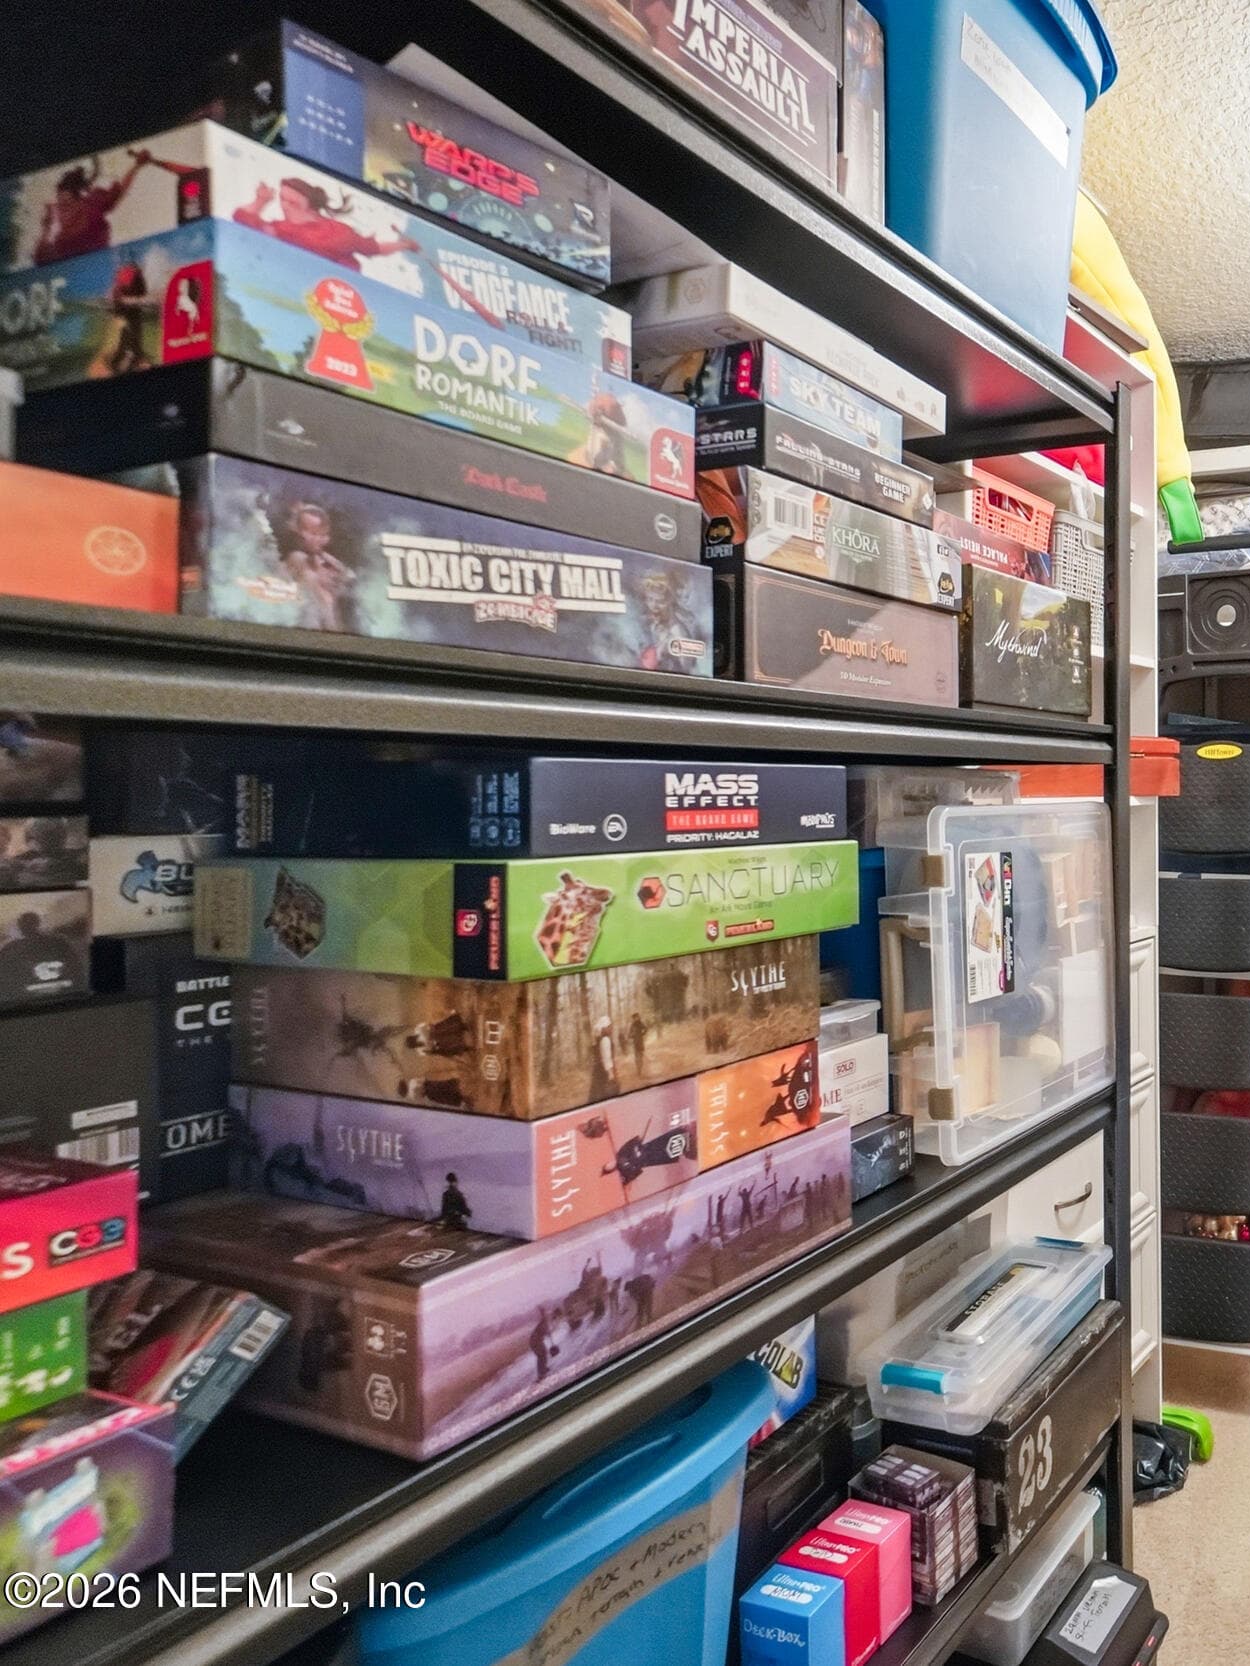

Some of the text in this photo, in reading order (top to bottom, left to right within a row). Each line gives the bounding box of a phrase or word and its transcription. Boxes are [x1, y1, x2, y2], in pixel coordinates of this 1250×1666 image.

[686, 25, 802, 131] ASSAULT
[424, 147, 525, 207] EDGE
[439, 262, 574, 332] VENGEANCE
[325, 356, 359, 378] 2023
[413, 314, 543, 395] DORF
[415, 363, 540, 426] ROMANTIK
[438, 401, 457, 414] THE
[789, 377, 882, 435] SKY TEAM
[699, 427, 758, 446] STARS
[874, 472, 911, 496] BEGINNER
[882, 487, 905, 503] GAME
[705, 544, 734, 559] EXPERT
[831, 526, 881, 556] KHÔRA
[382, 546, 625, 602] TOXIC CITY MALL
[817, 628, 868, 659] Dungeon
[880, 639, 908, 666] Town
[985, 619, 1048, 663] Mythwind
[664, 773, 760, 797] MASS
[664, 795, 760, 809] EFFECT
[549, 823, 597, 837] BioWare
[671, 812, 756, 826] THE BOARD GAME
[714, 830, 760, 842] HAGALAZ
[666, 860, 840, 908] SANCTUARY
[176, 975, 231, 994] BATTLE
[730, 961, 787, 997] SCYTHE
[835, 1060, 855, 1073] SOLO
[709, 1082, 731, 1157] SCYTHE
[336, 1124, 403, 1163] SCYTHE
[551, 1129, 582, 1218] SCYTHE
[1018, 1414, 1053, 1516] 23
